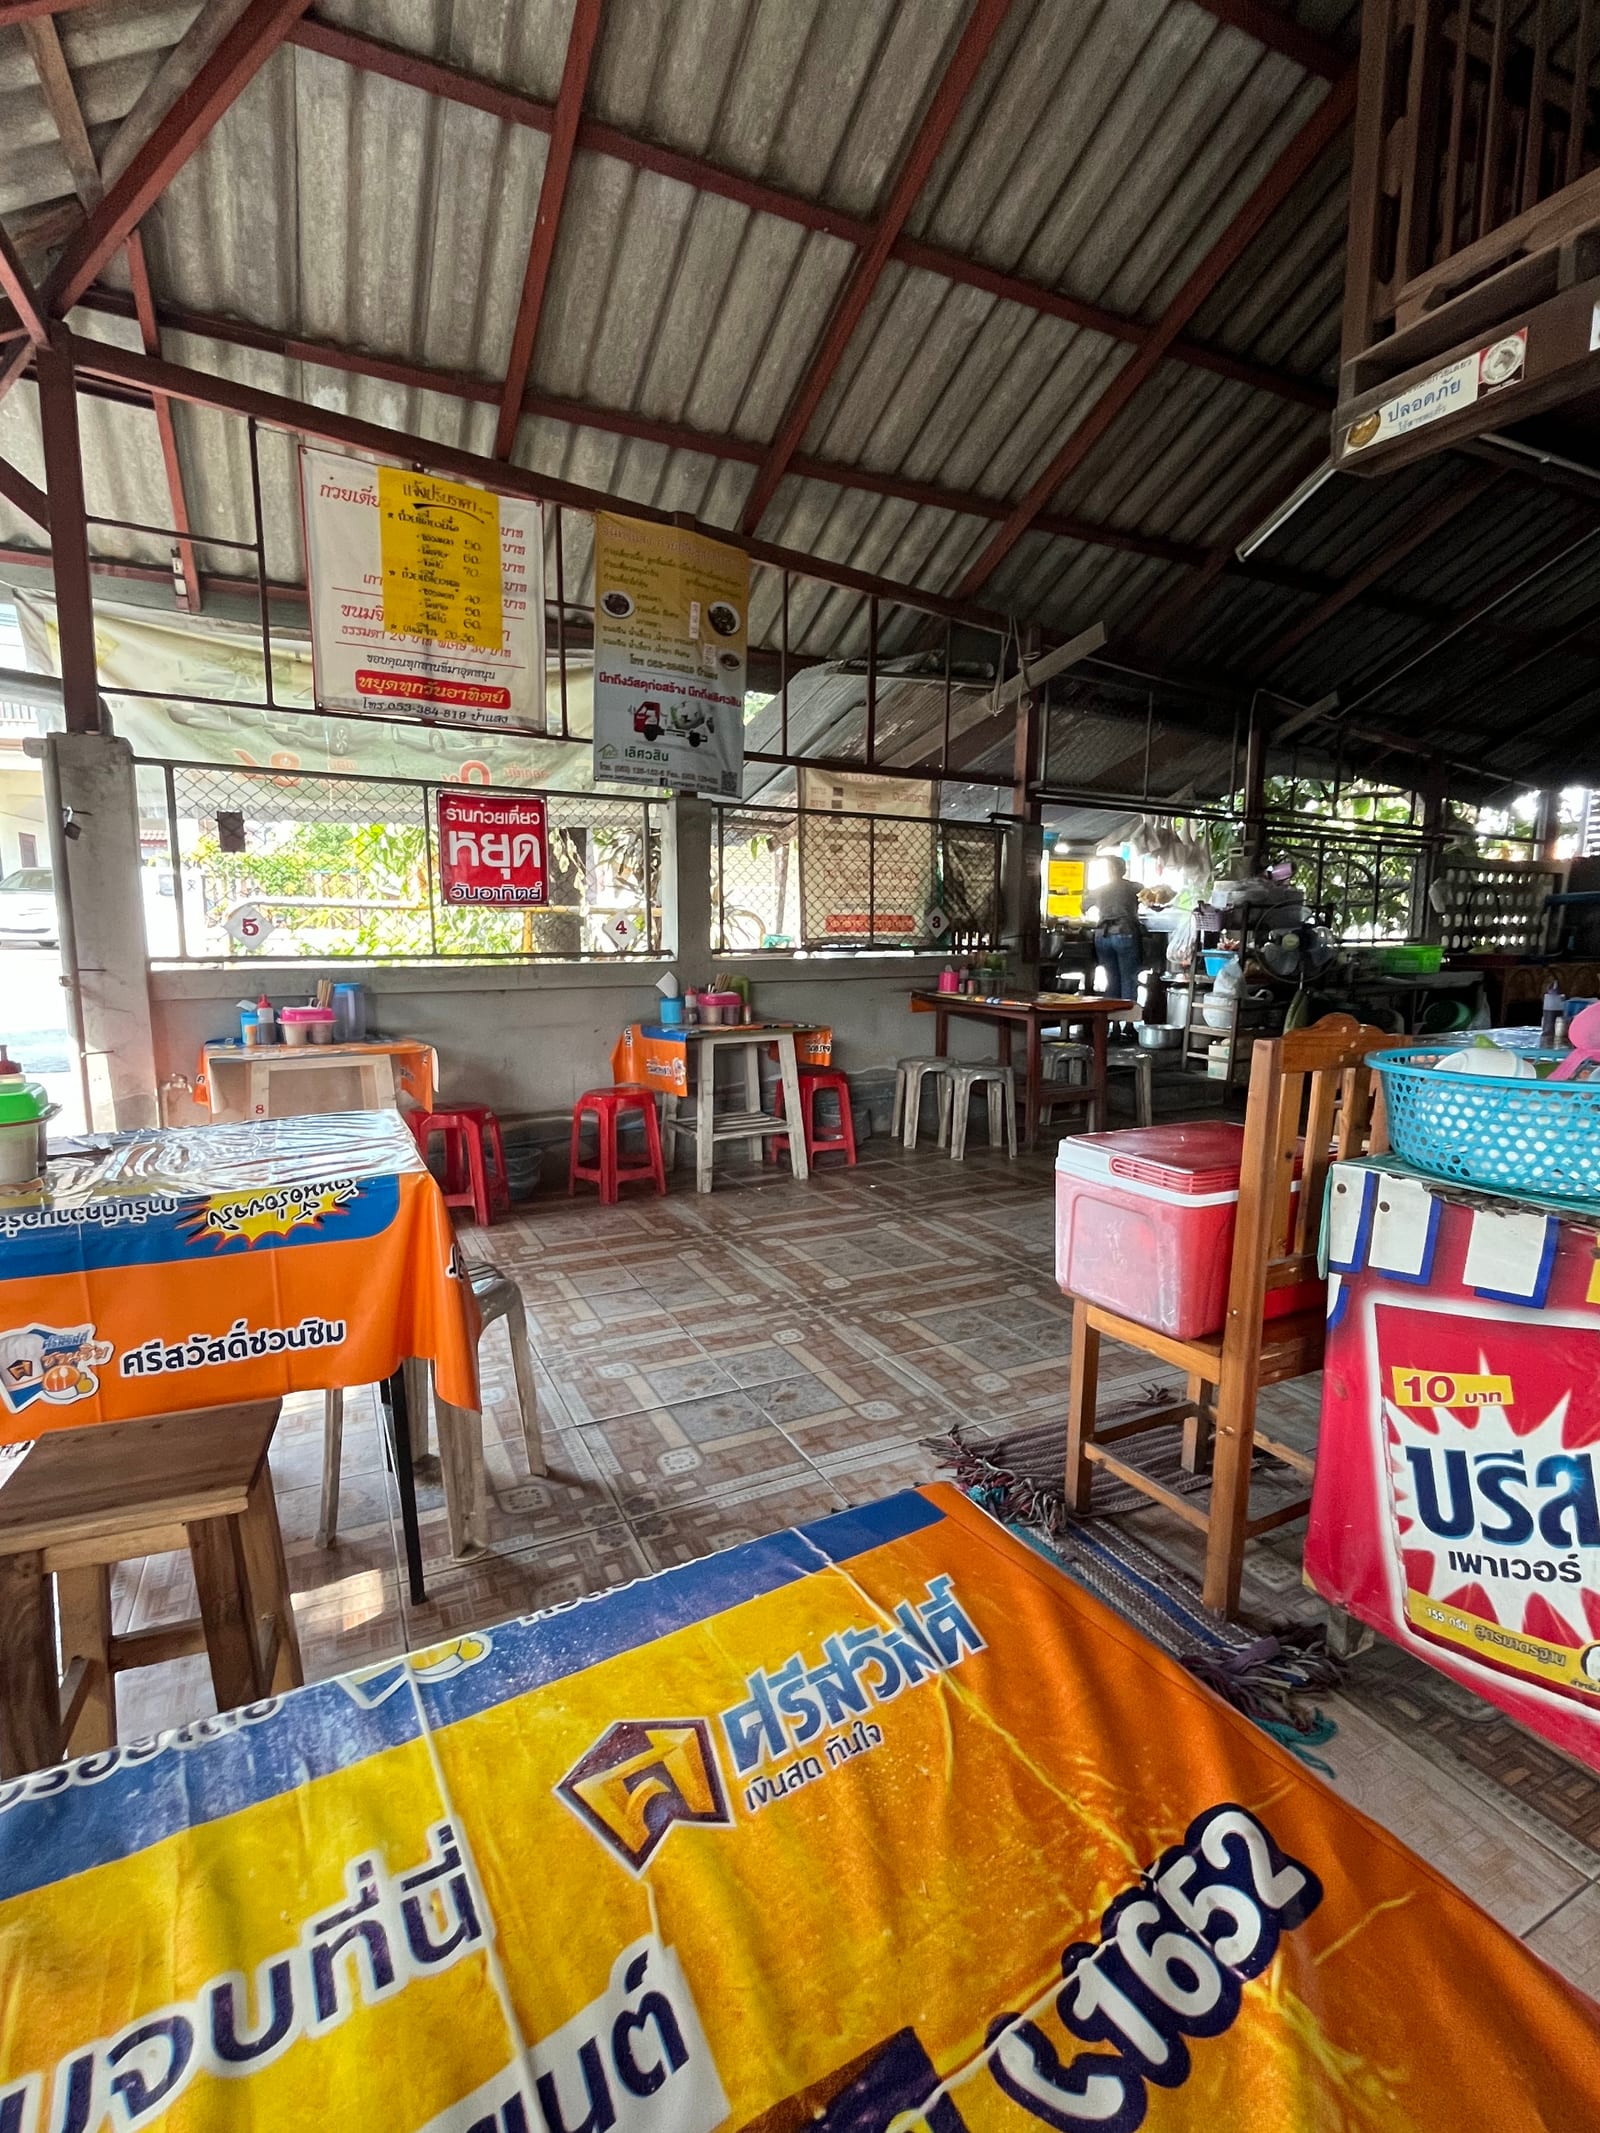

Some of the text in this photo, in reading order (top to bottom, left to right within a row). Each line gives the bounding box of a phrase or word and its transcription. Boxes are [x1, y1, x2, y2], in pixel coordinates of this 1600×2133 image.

[1387, 375, 1462, 424] ปลอดภัย
[319, 476, 380, 508] ก๋วยเตี๋ย
[501, 526, 524, 540] บาท
[502, 543, 525, 556] บาท
[502, 562, 525, 575] บาท
[363, 574, 383, 587] เกา
[504, 581, 527, 594] บาท
[503, 599, 527, 611] บาท
[341, 622, 385, 642] ธรรมดา
[358, 675, 505, 705] หยุดทุกวันอาทิตย์
[599, 671, 687, 695] นึกถึงวัสดุก่อสร้าง
[470, 707, 509, 724] ป้าแสง
[624, 746, 669, 763] เลิศวสิน
[446, 800, 541, 825] ร้านก๋วยเตี๋ยว
[448, 830, 541, 880] หยุด
[450, 881, 543, 902] วันอาทิตย์
[242, 917, 259, 936] 5
[615, 920, 628, 935] 4
[255, 1104, 264, 1115] 8
[122, 1317, 345, 1377] ศรีสวัสดิ์ชวนชิม
[1403, 1375, 1503, 1404] 10 บาท
[1448, 1551, 1583, 1584] เพาเวอร์
[1426, 1607, 1567, 1667] 155 กรัม สูตรมาตรฐาน
[719, 1573, 988, 1777] ศรีสวัสดิ์
[745, 1720, 883, 1813] เงินสด ทันใจ
[1070, 1807, 1314, 2070] 1652
